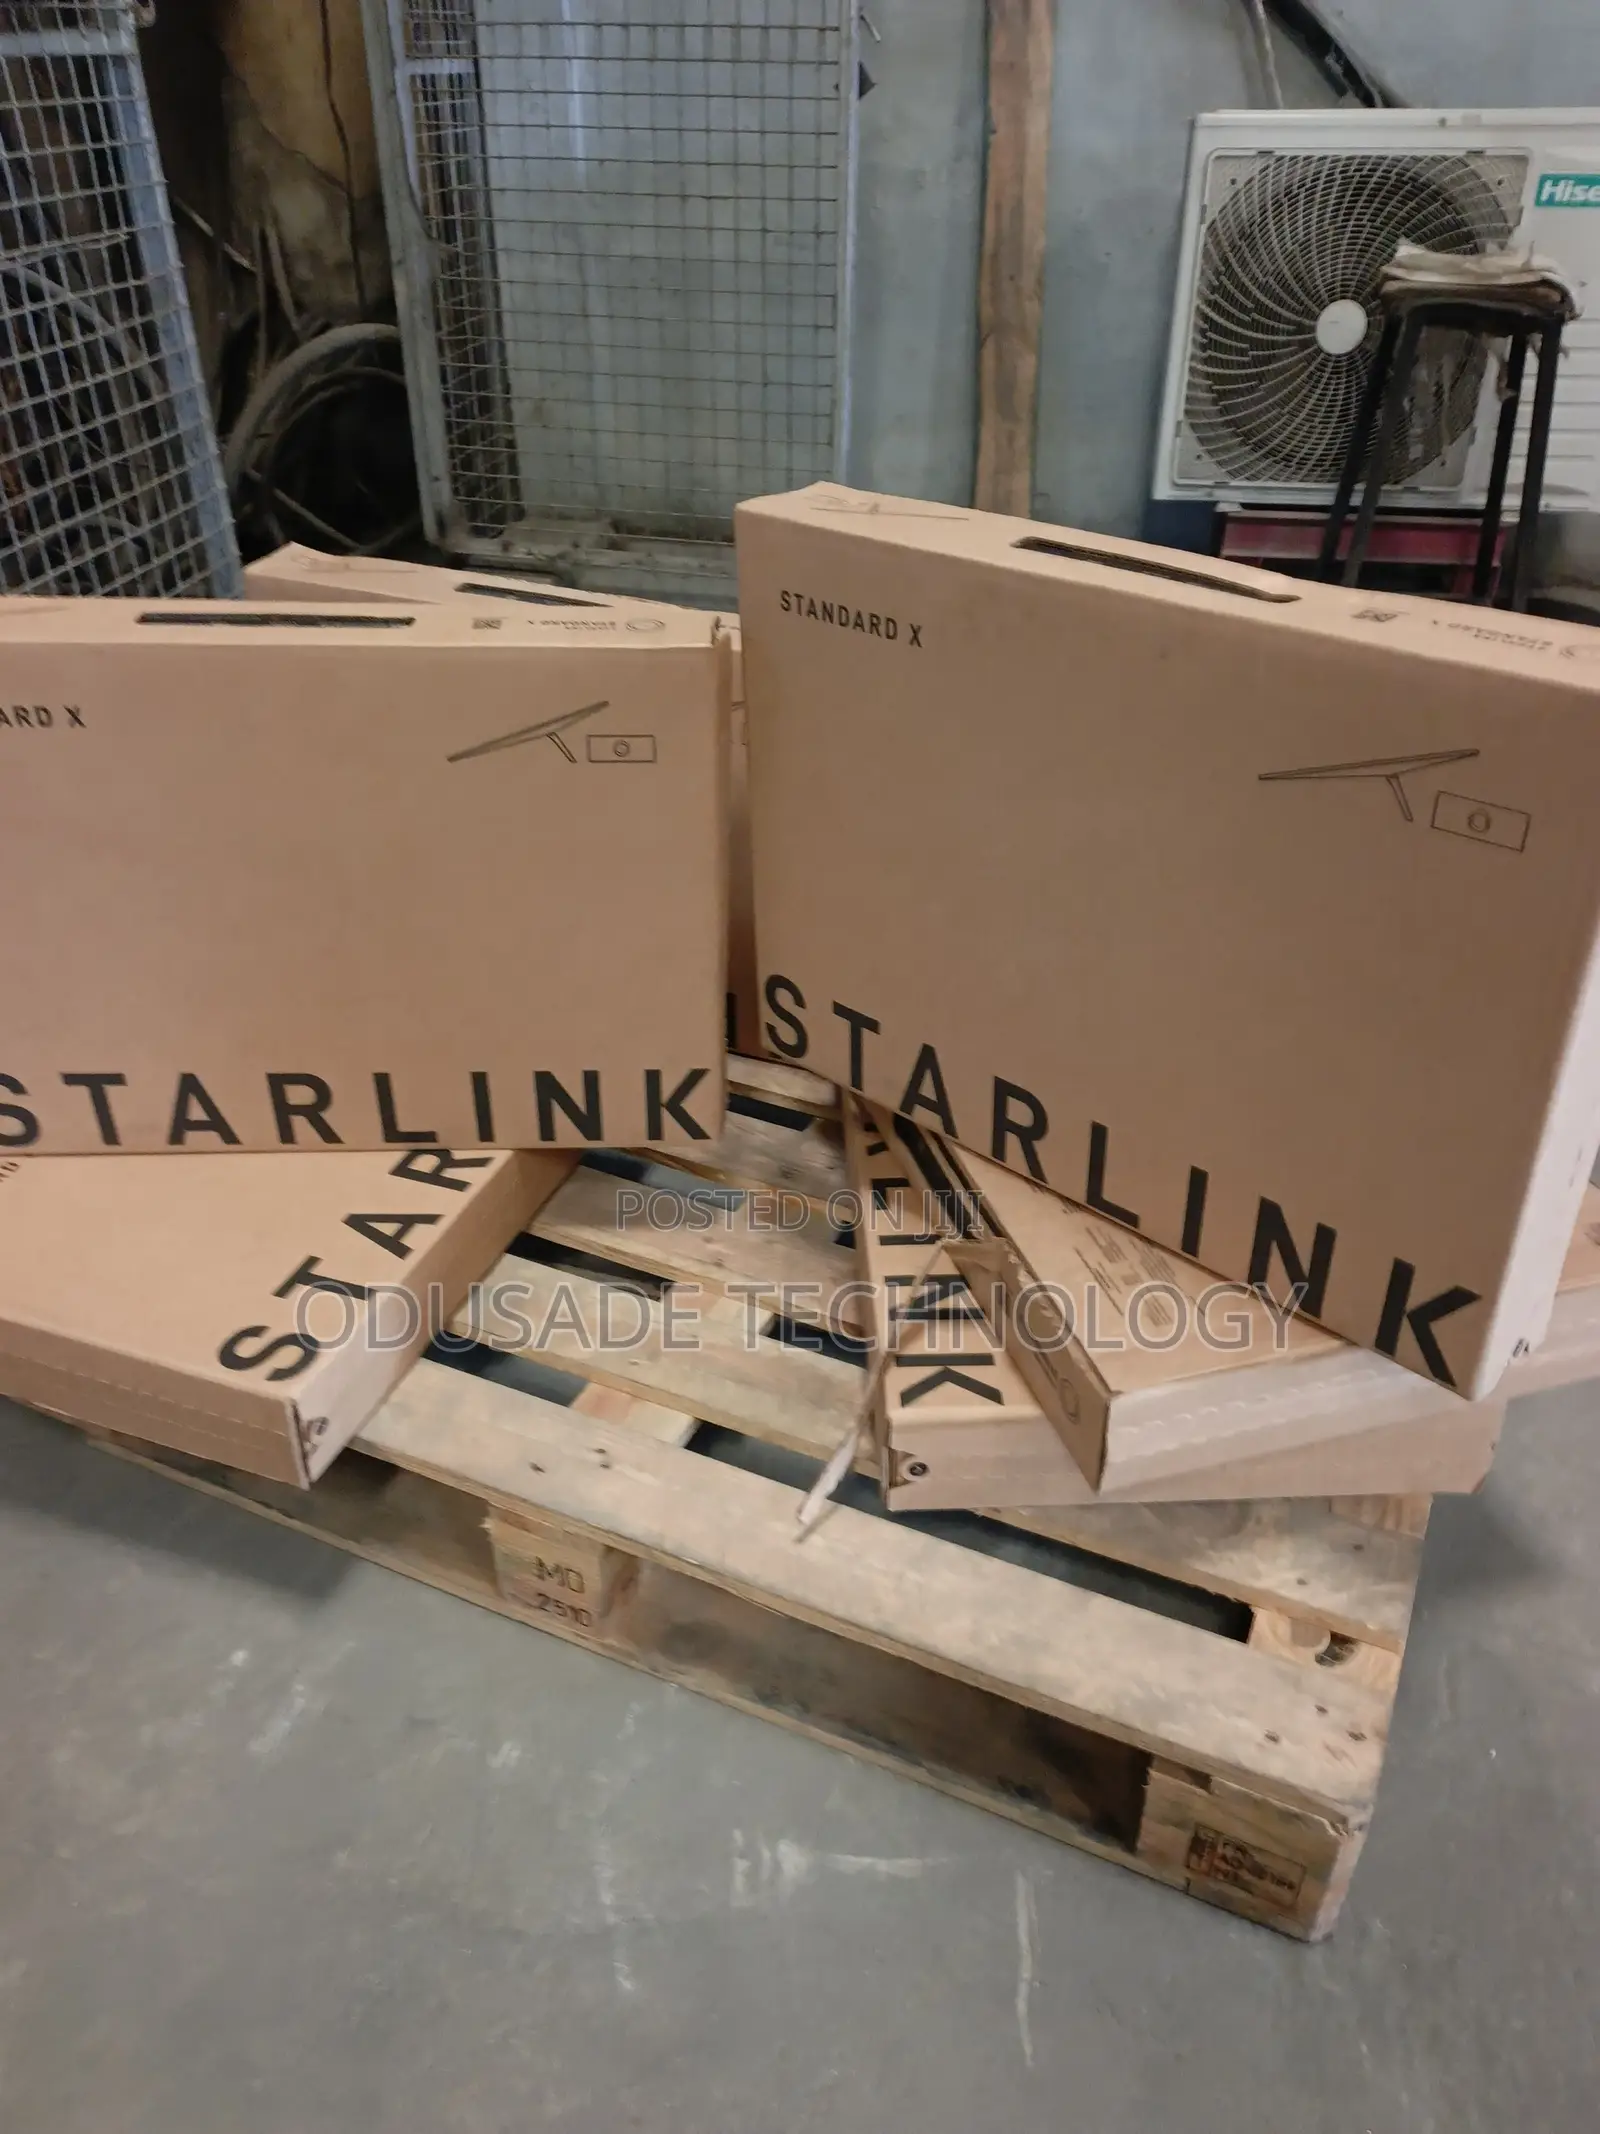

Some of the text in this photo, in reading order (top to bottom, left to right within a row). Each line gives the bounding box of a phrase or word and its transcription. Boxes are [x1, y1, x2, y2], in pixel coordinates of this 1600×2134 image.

[779, 589, 923, 648] STANDARD X
[63, 704, 87, 728] X
[0, 1069, 711, 1147] STARLINK
[764, 974, 1482, 1388] STARLINK
[219, 1148, 496, 1382] STAR
